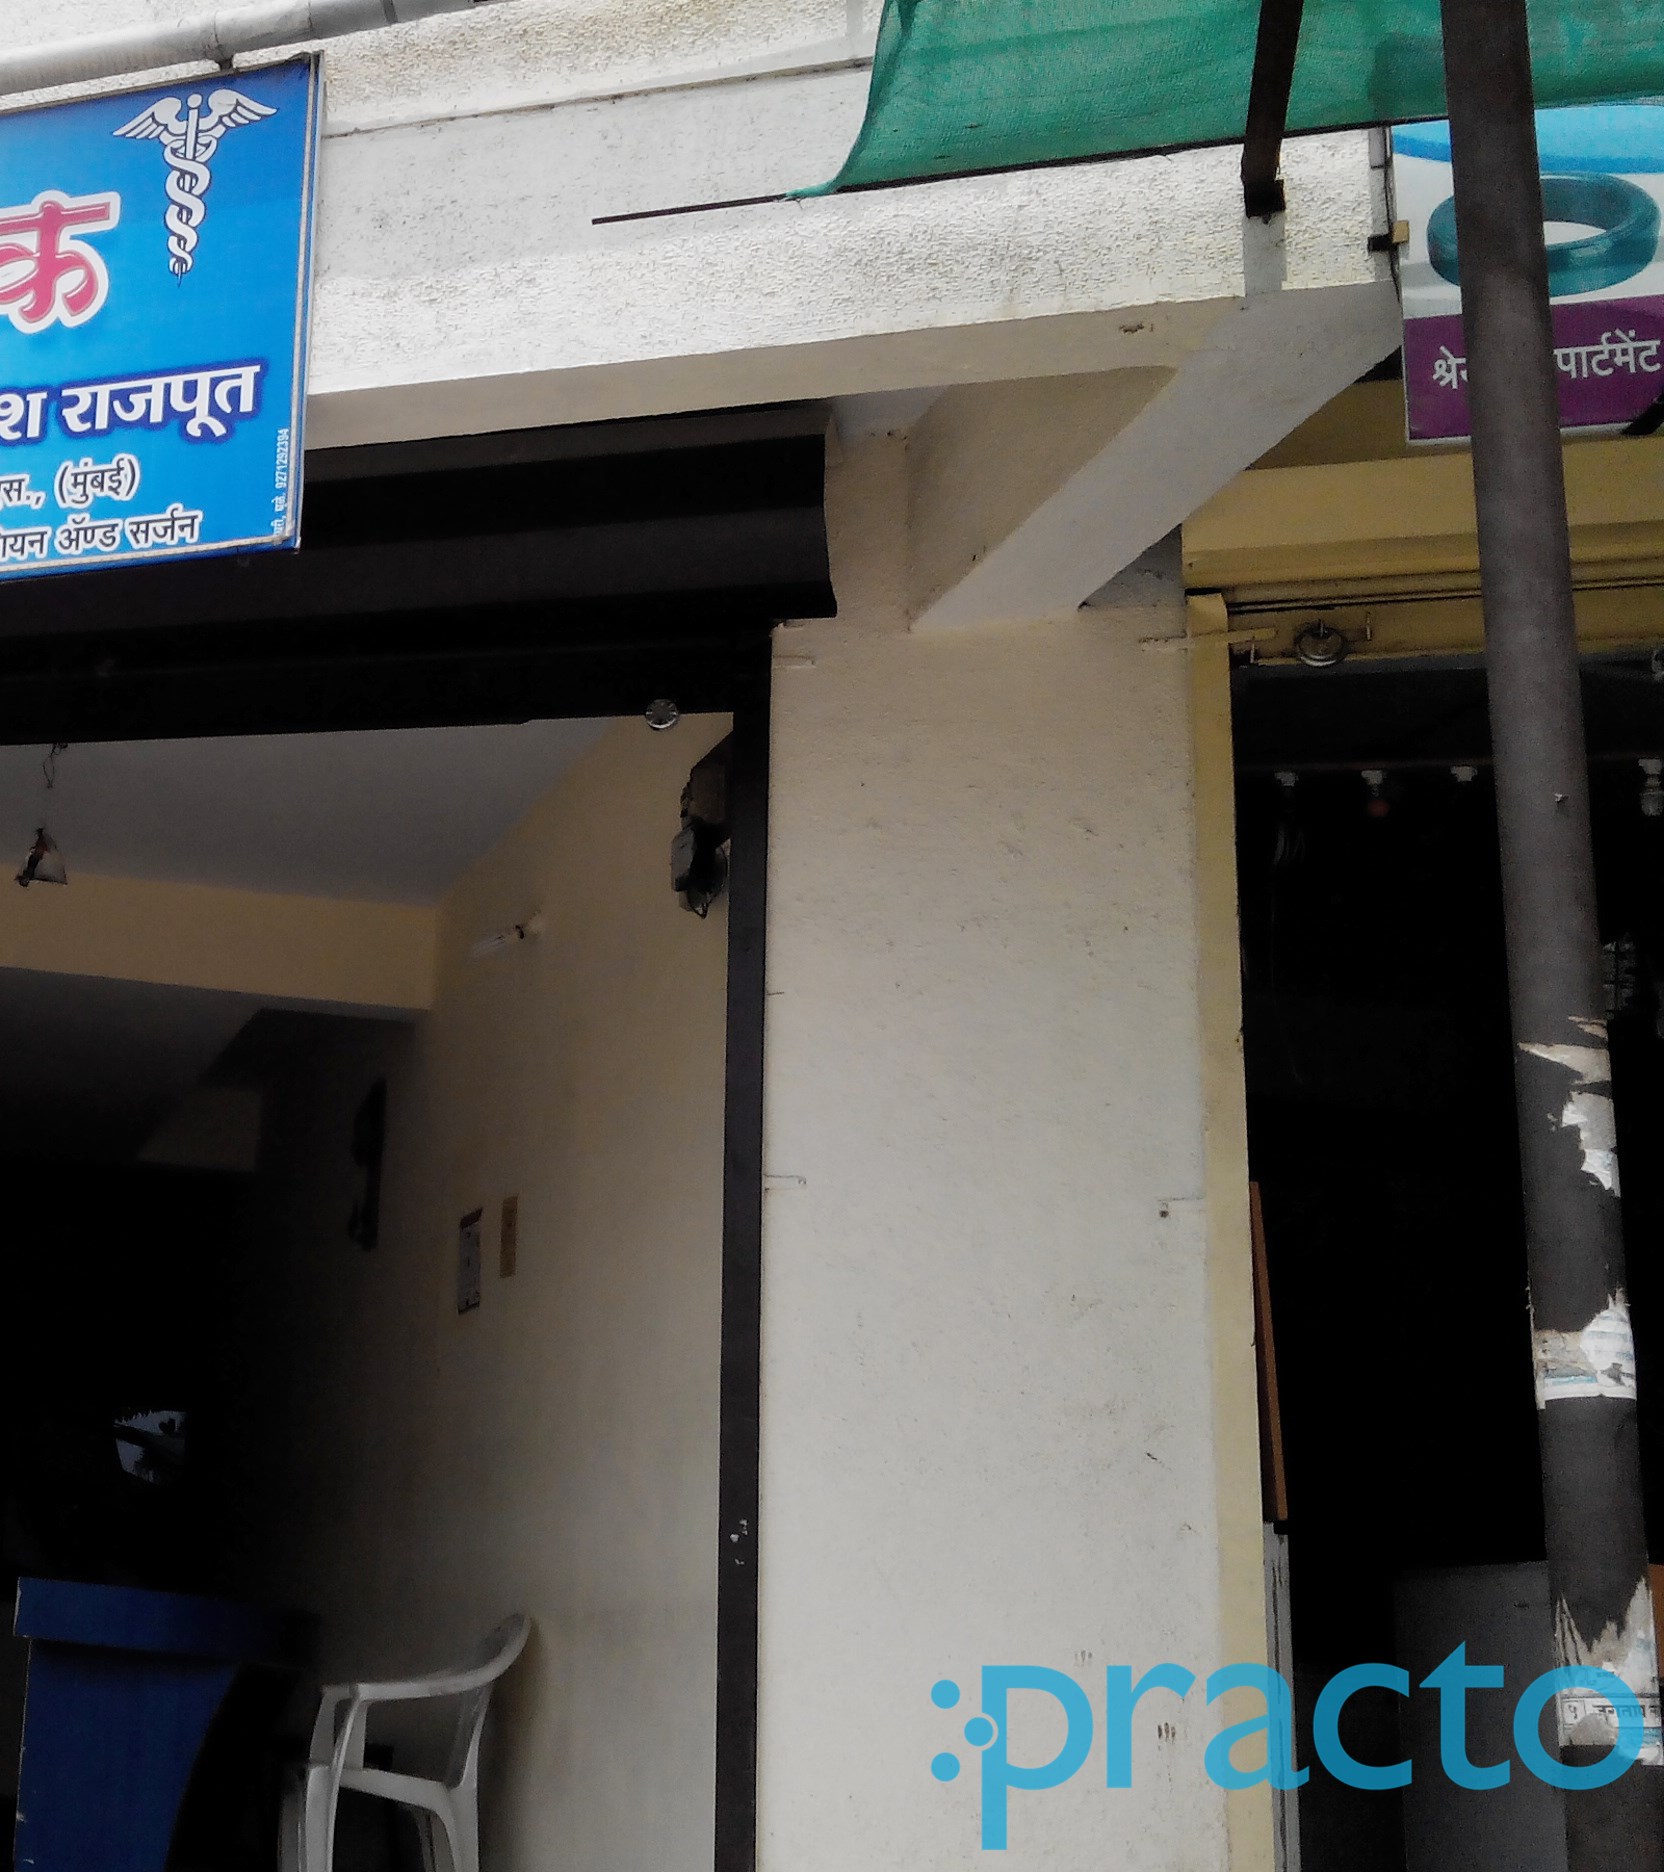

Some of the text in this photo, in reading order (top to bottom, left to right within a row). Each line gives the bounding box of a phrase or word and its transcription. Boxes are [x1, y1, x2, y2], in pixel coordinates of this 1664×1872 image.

[1552, 328, 1661, 379] पार्टमेंट
[60, 365, 261, 438] राजपूत
[57, 457, 138, 503] (मुंबई)
[129, 506, 200, 544] सर्जन
